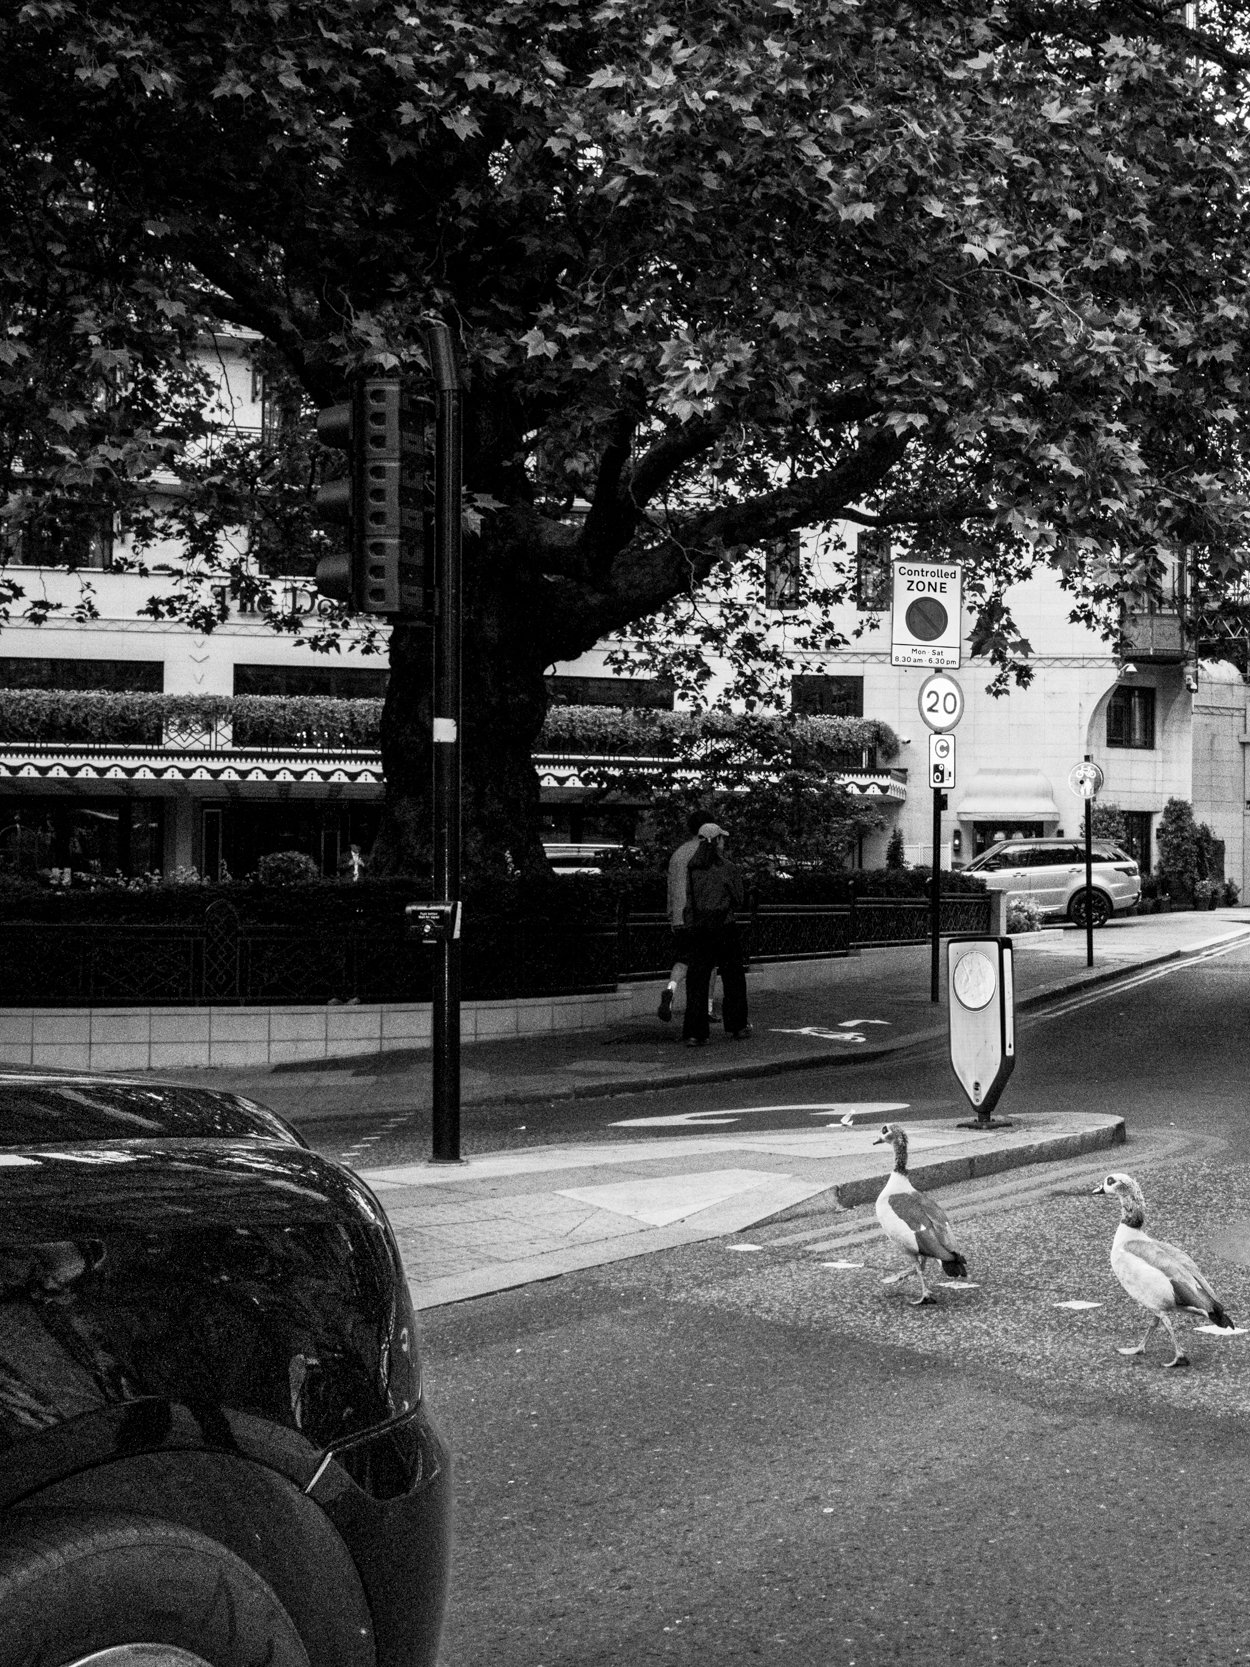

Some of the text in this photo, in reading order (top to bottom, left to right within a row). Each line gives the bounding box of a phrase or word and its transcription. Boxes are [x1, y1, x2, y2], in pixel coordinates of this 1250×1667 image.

[898, 566, 957, 579] Controlled
[906, 580, 948, 593] ZONE
[928, 657, 945, 665] 6.30
[926, 690, 957, 714] 20
[935, 739, 949, 758] C
